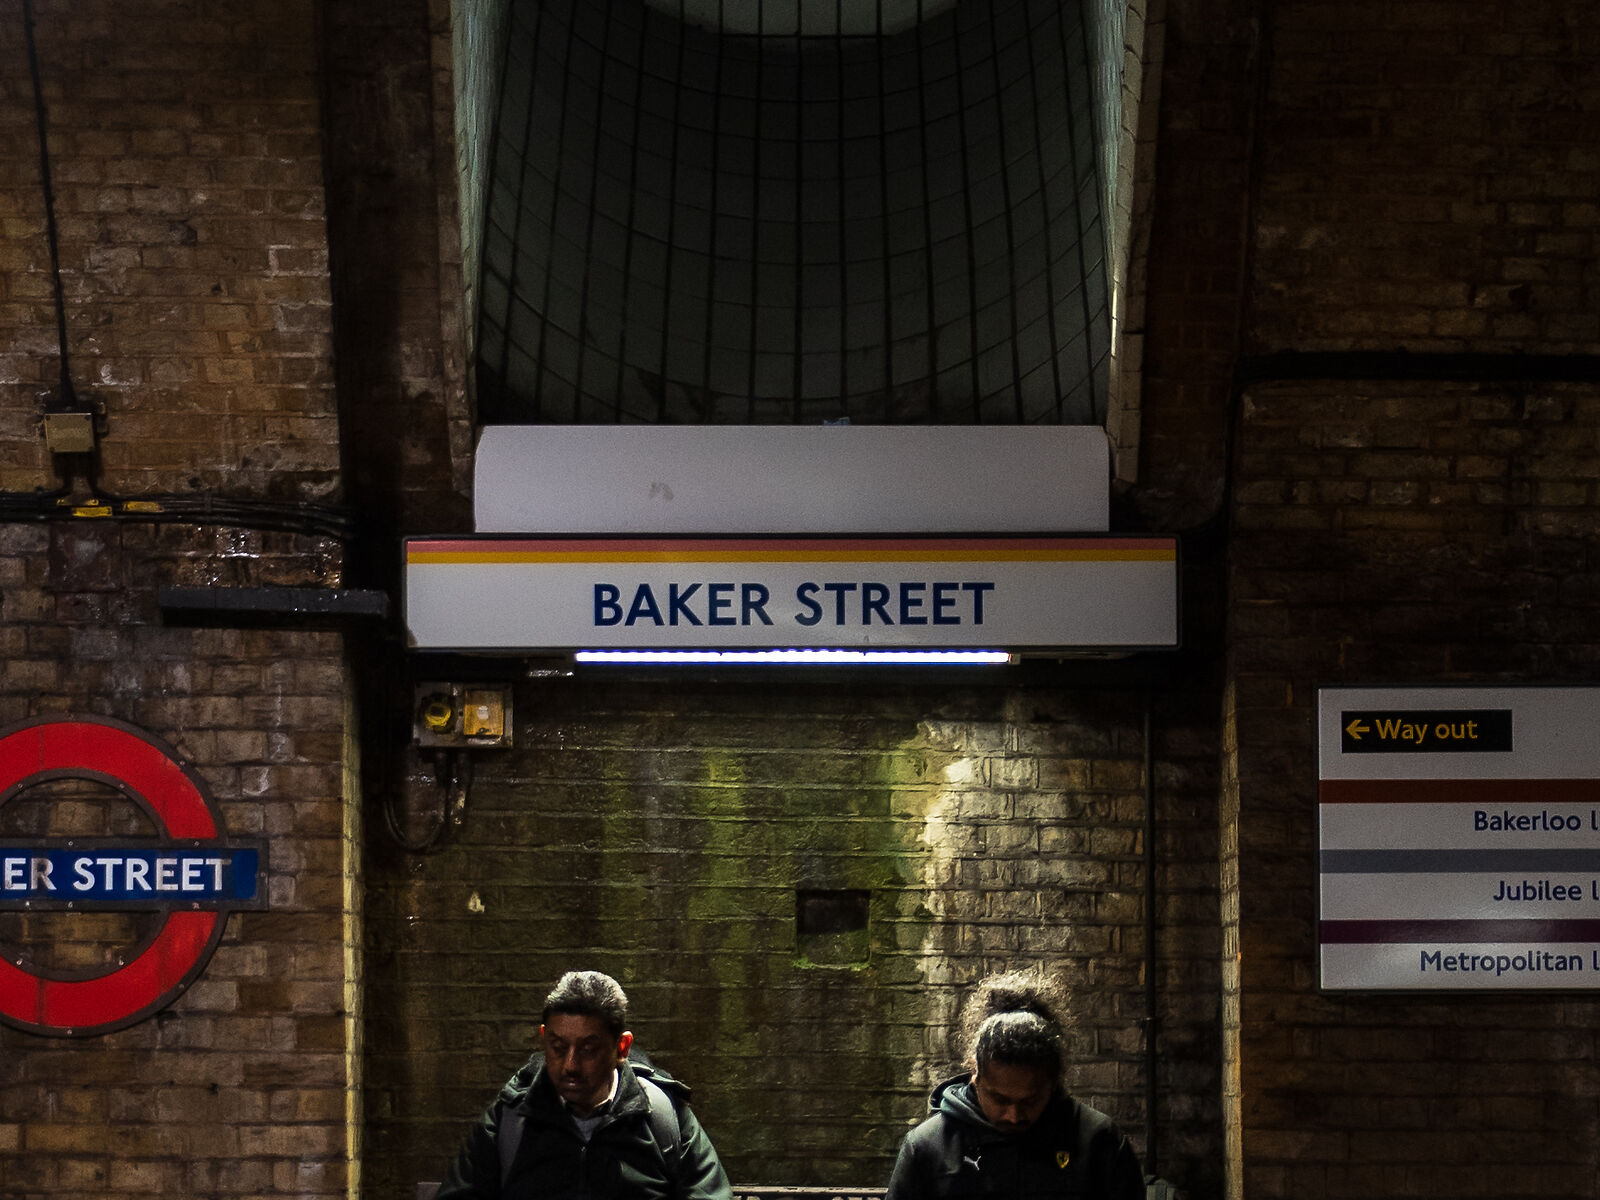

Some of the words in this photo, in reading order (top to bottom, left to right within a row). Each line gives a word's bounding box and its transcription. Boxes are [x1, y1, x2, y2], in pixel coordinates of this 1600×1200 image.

[594, 583, 774, 626] BAKER
[794, 582, 995, 626] STREET
[1375, 719, 1428, 744] Way
[1434, 720, 1479, 740] out
[1474, 810, 1581, 831] Bakerloo
[72, 857, 232, 891] STREET
[1493, 880, 1582, 901] Jubilee
[1420, 950, 1583, 976] Metropolitan
